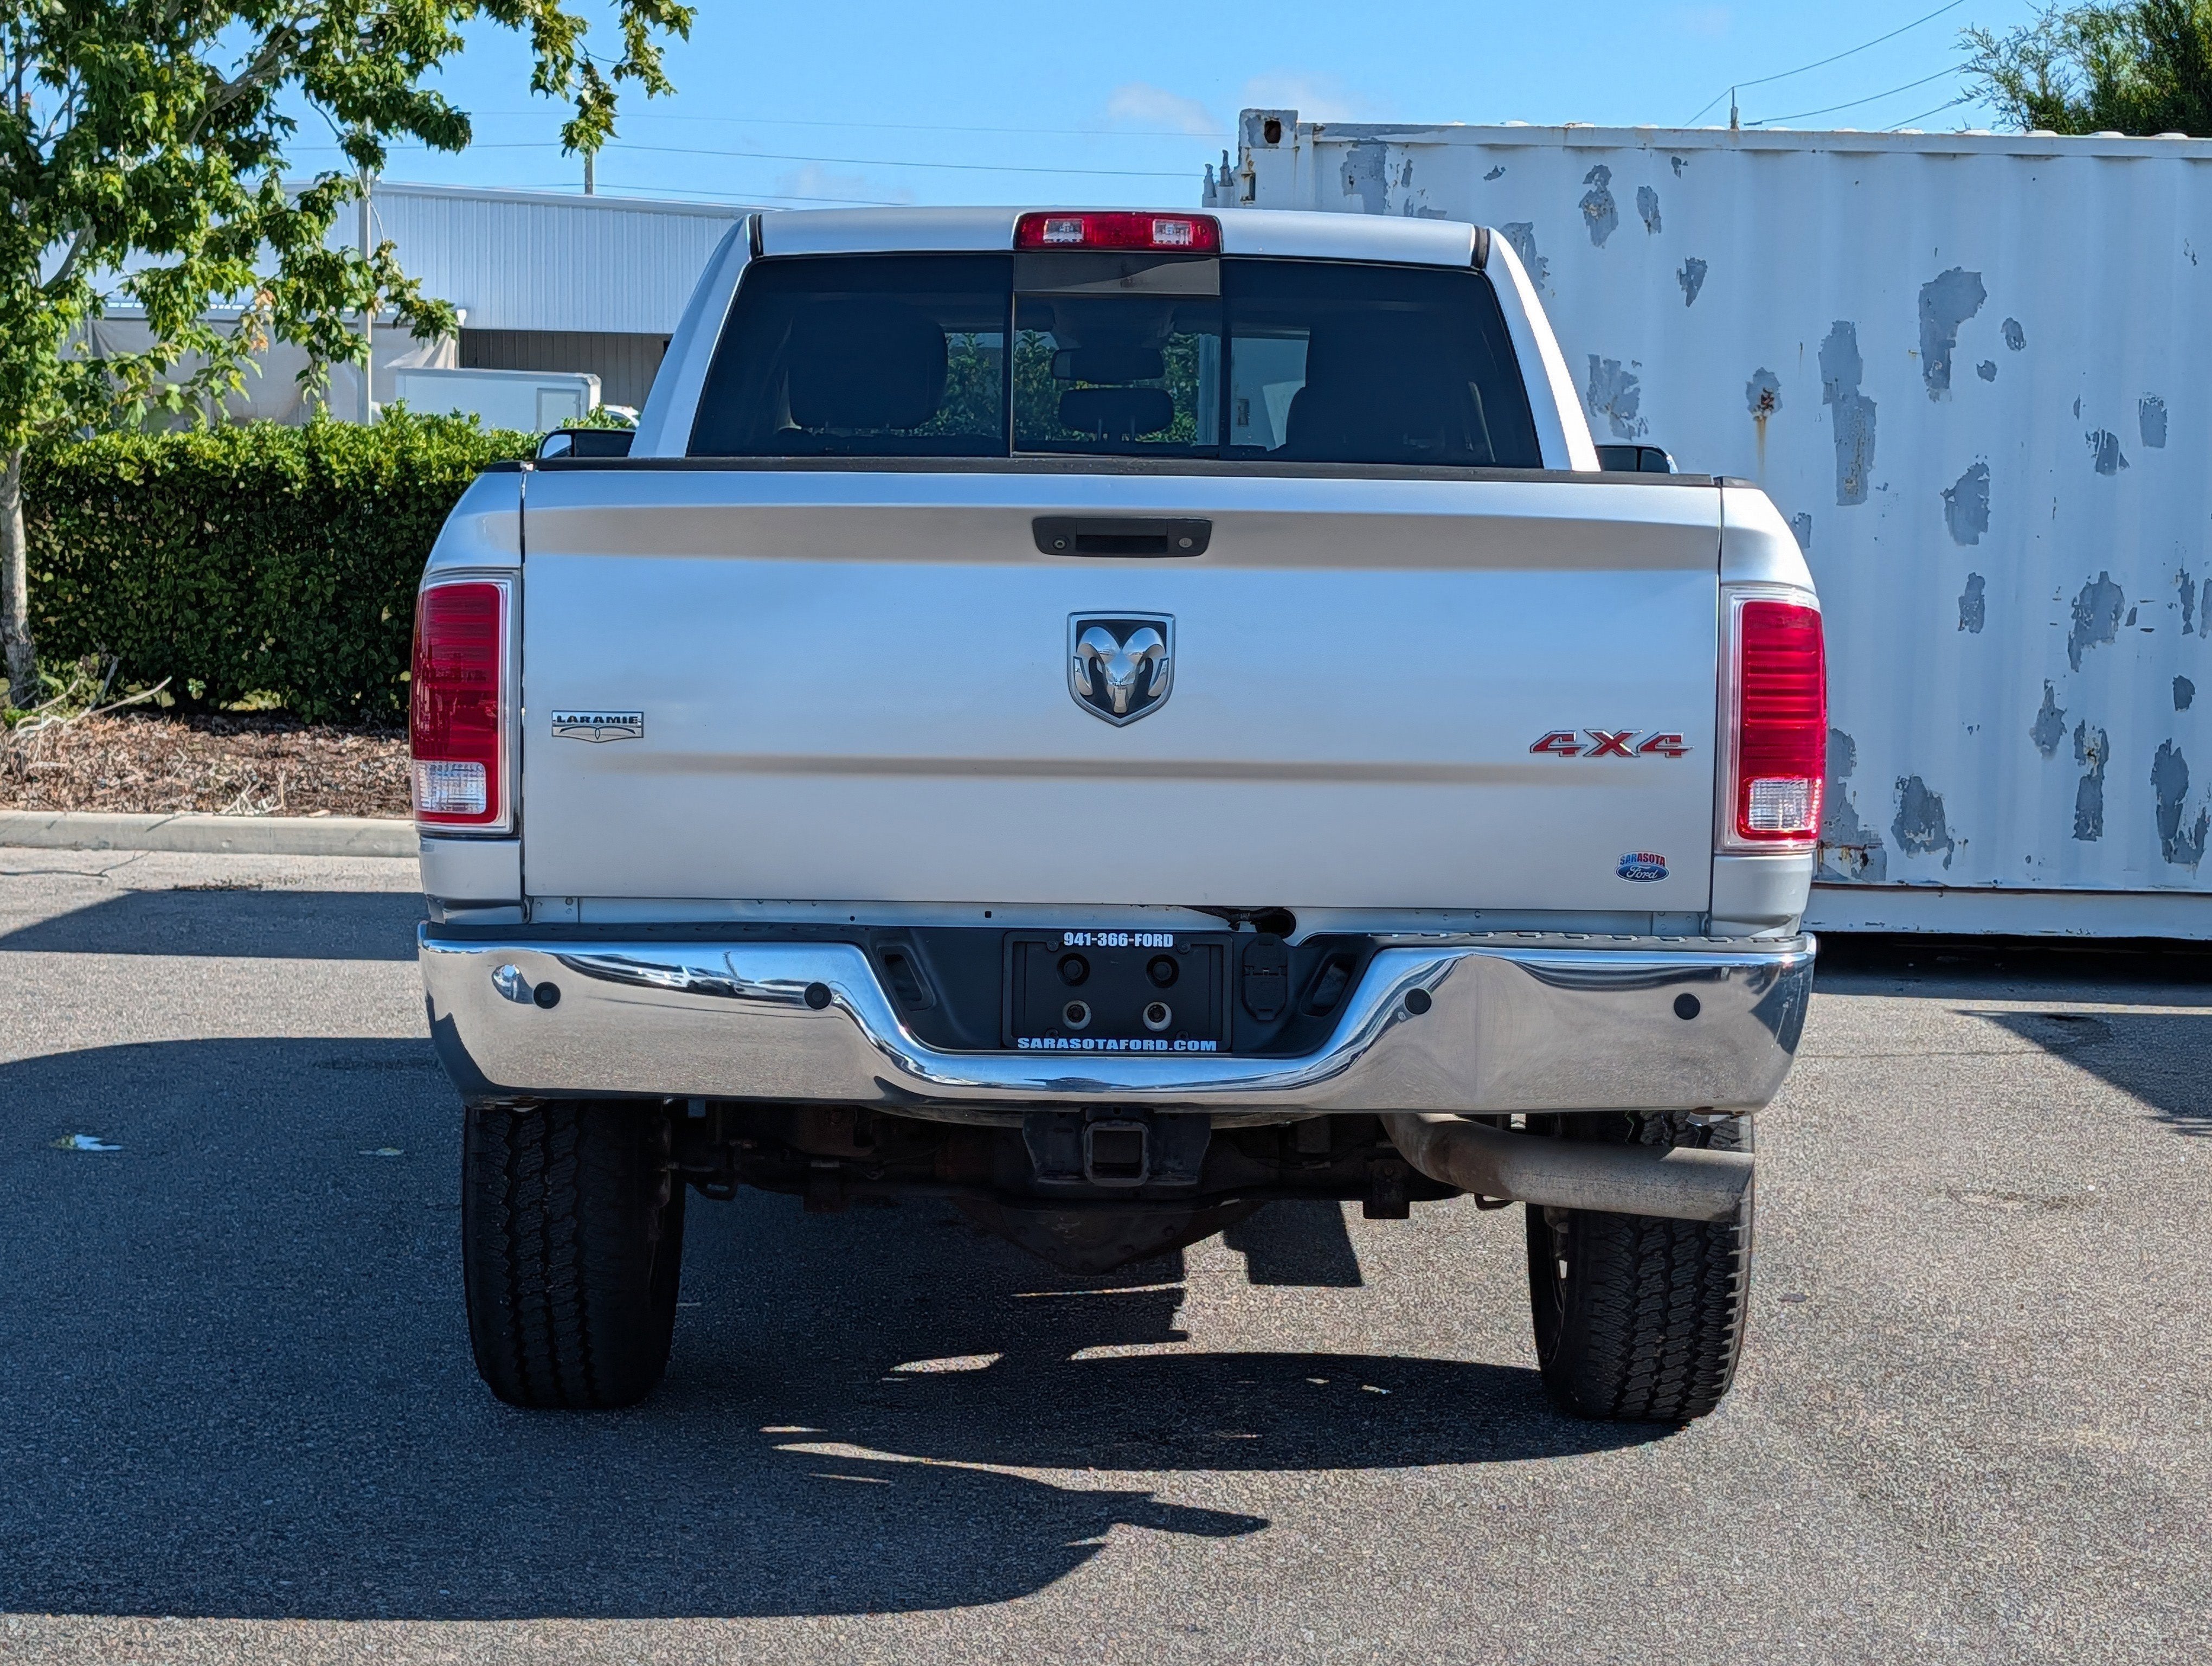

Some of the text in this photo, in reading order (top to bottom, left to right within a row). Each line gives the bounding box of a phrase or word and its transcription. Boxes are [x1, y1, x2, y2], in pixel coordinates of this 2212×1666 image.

[556, 715, 639, 724] LARAMIE
[1530, 728, 1695, 758] 4X4
[1620, 853, 1666, 867] SARASOTA
[1626, 865, 1658, 879] Ford
[1063, 932, 1174, 947] 941-366-FORD
[1018, 1037, 1217, 1052] SARASOTAFORD.COM
